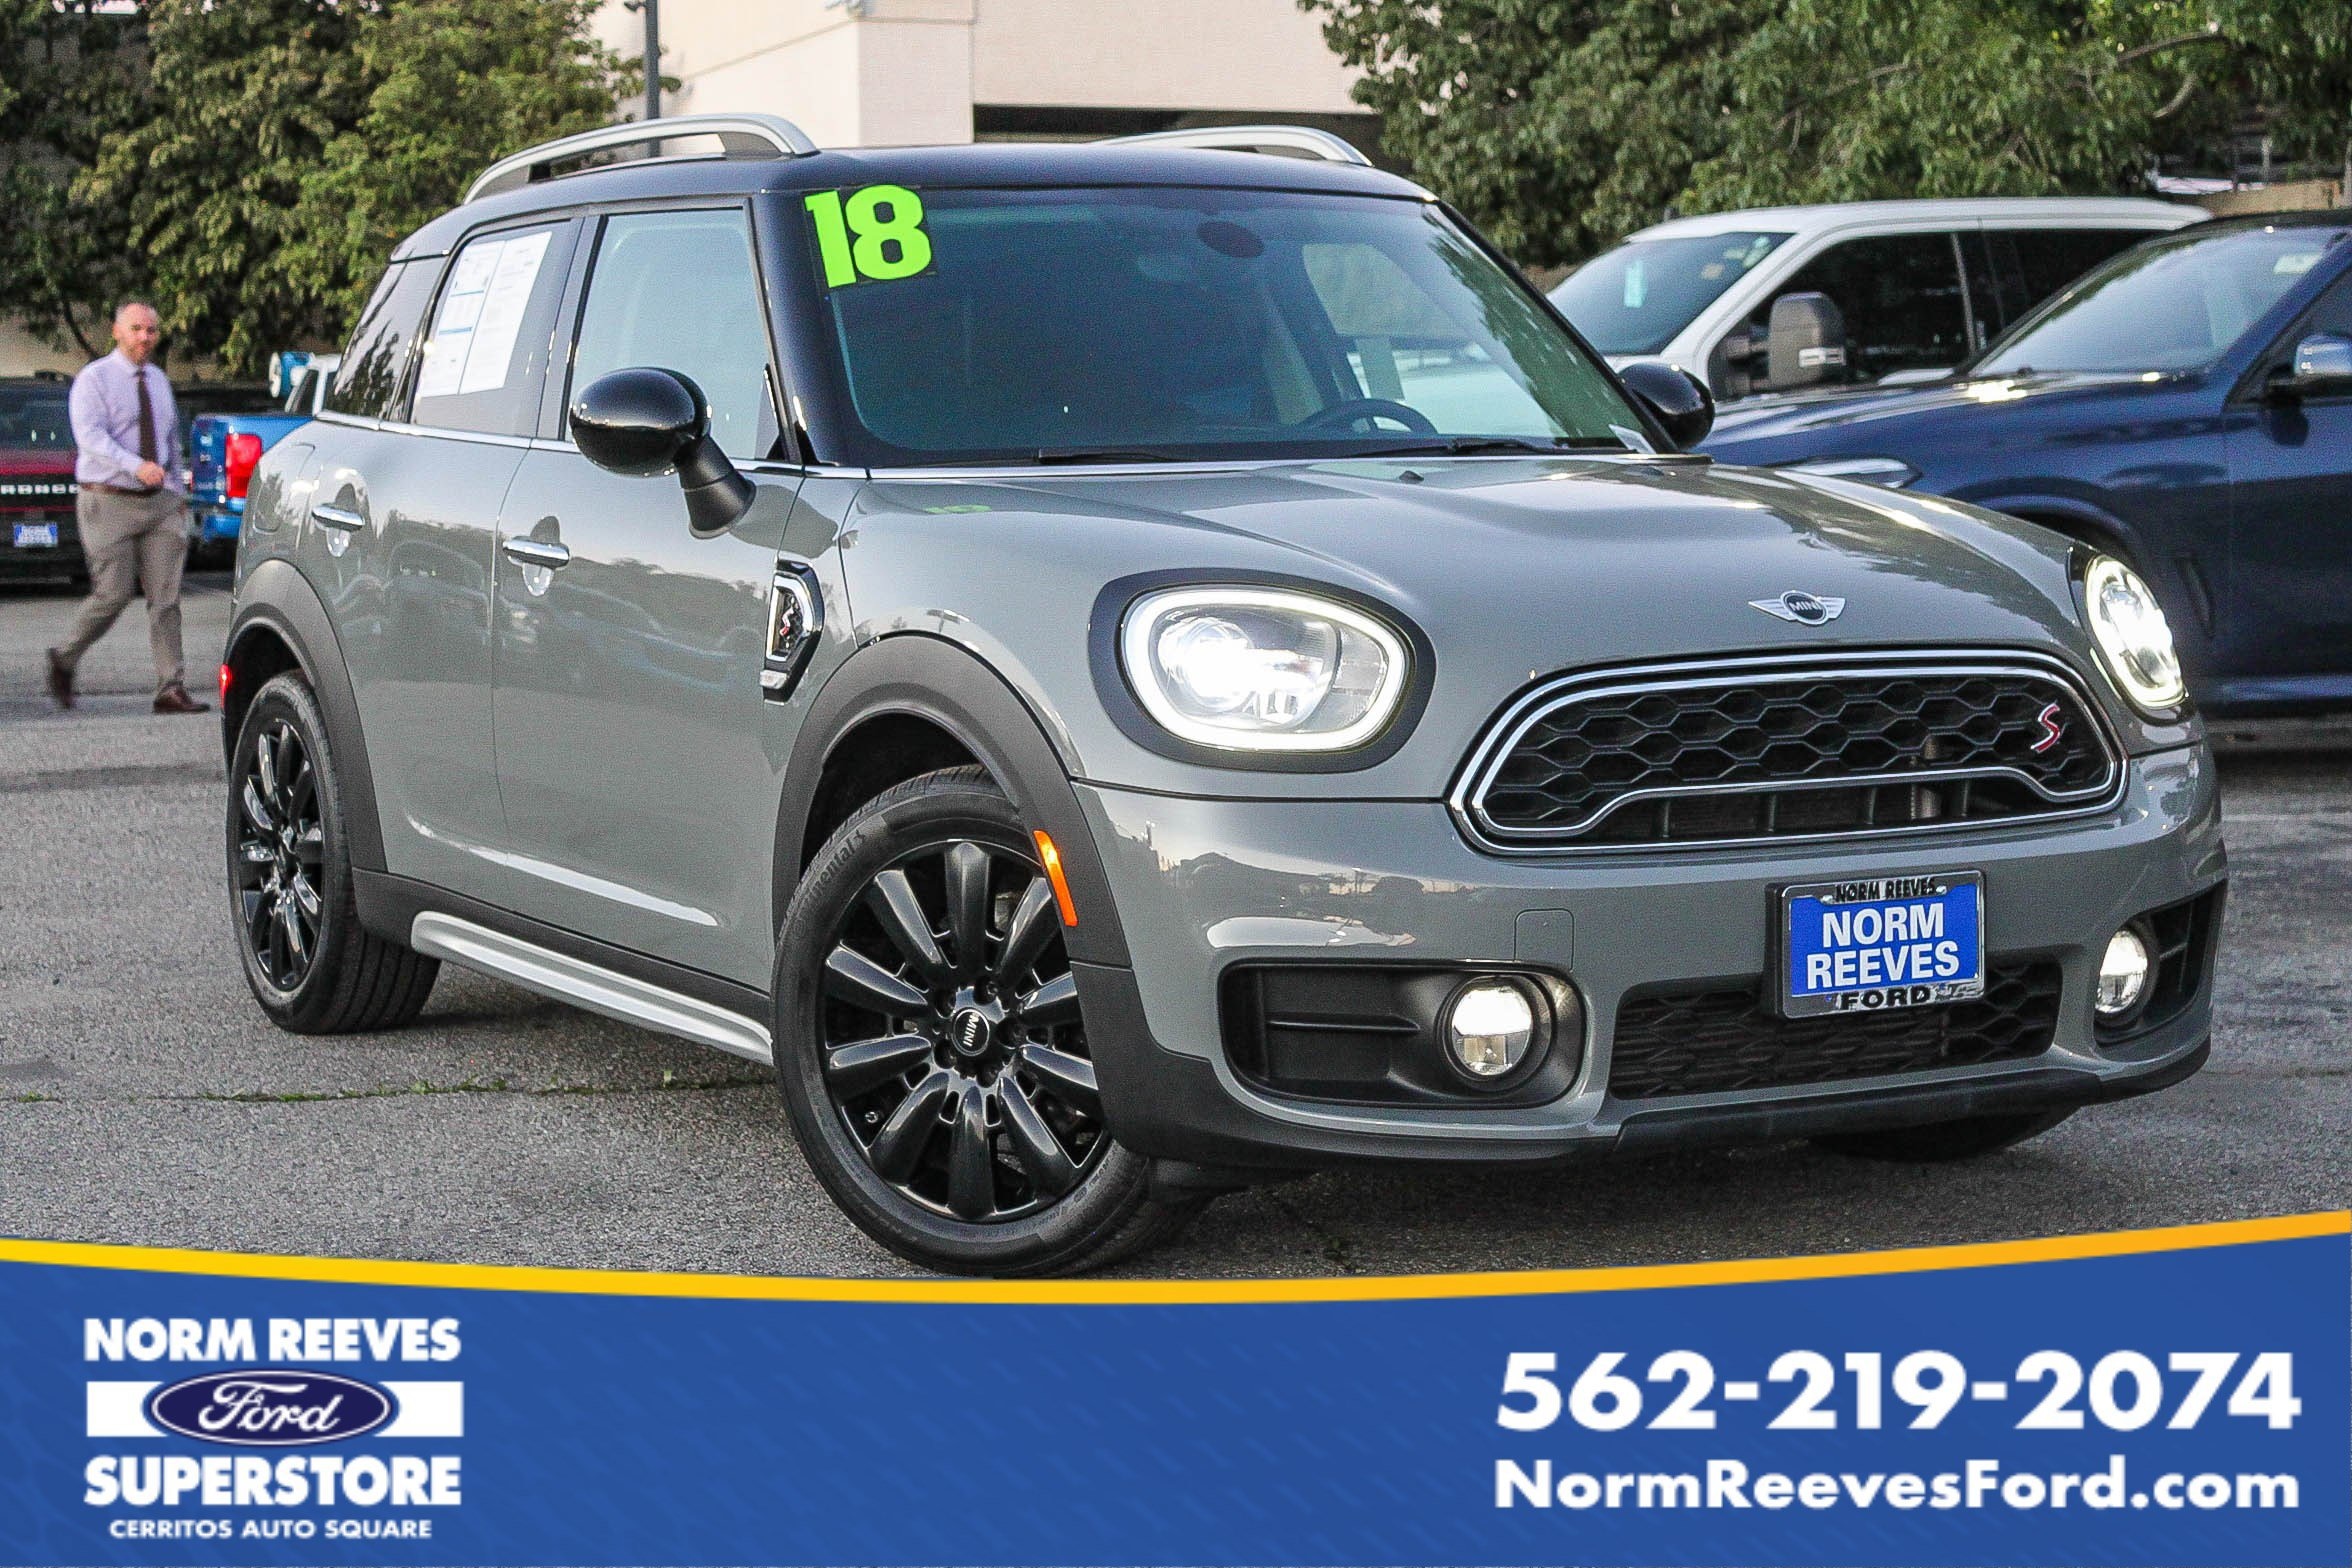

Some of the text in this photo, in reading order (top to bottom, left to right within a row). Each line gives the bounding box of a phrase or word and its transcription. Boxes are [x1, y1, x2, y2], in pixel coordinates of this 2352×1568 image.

[804, 184, 932, 288] 18
[1789, 601, 1821, 612] MINI
[1835, 877, 1937, 902] NORM REEVES
[1823, 903, 1944, 948] NORM
[1807, 940, 1960, 990] REEVES
[1840, 985, 1931, 1010] FORD
[963, 1014, 977, 1047] MINI
